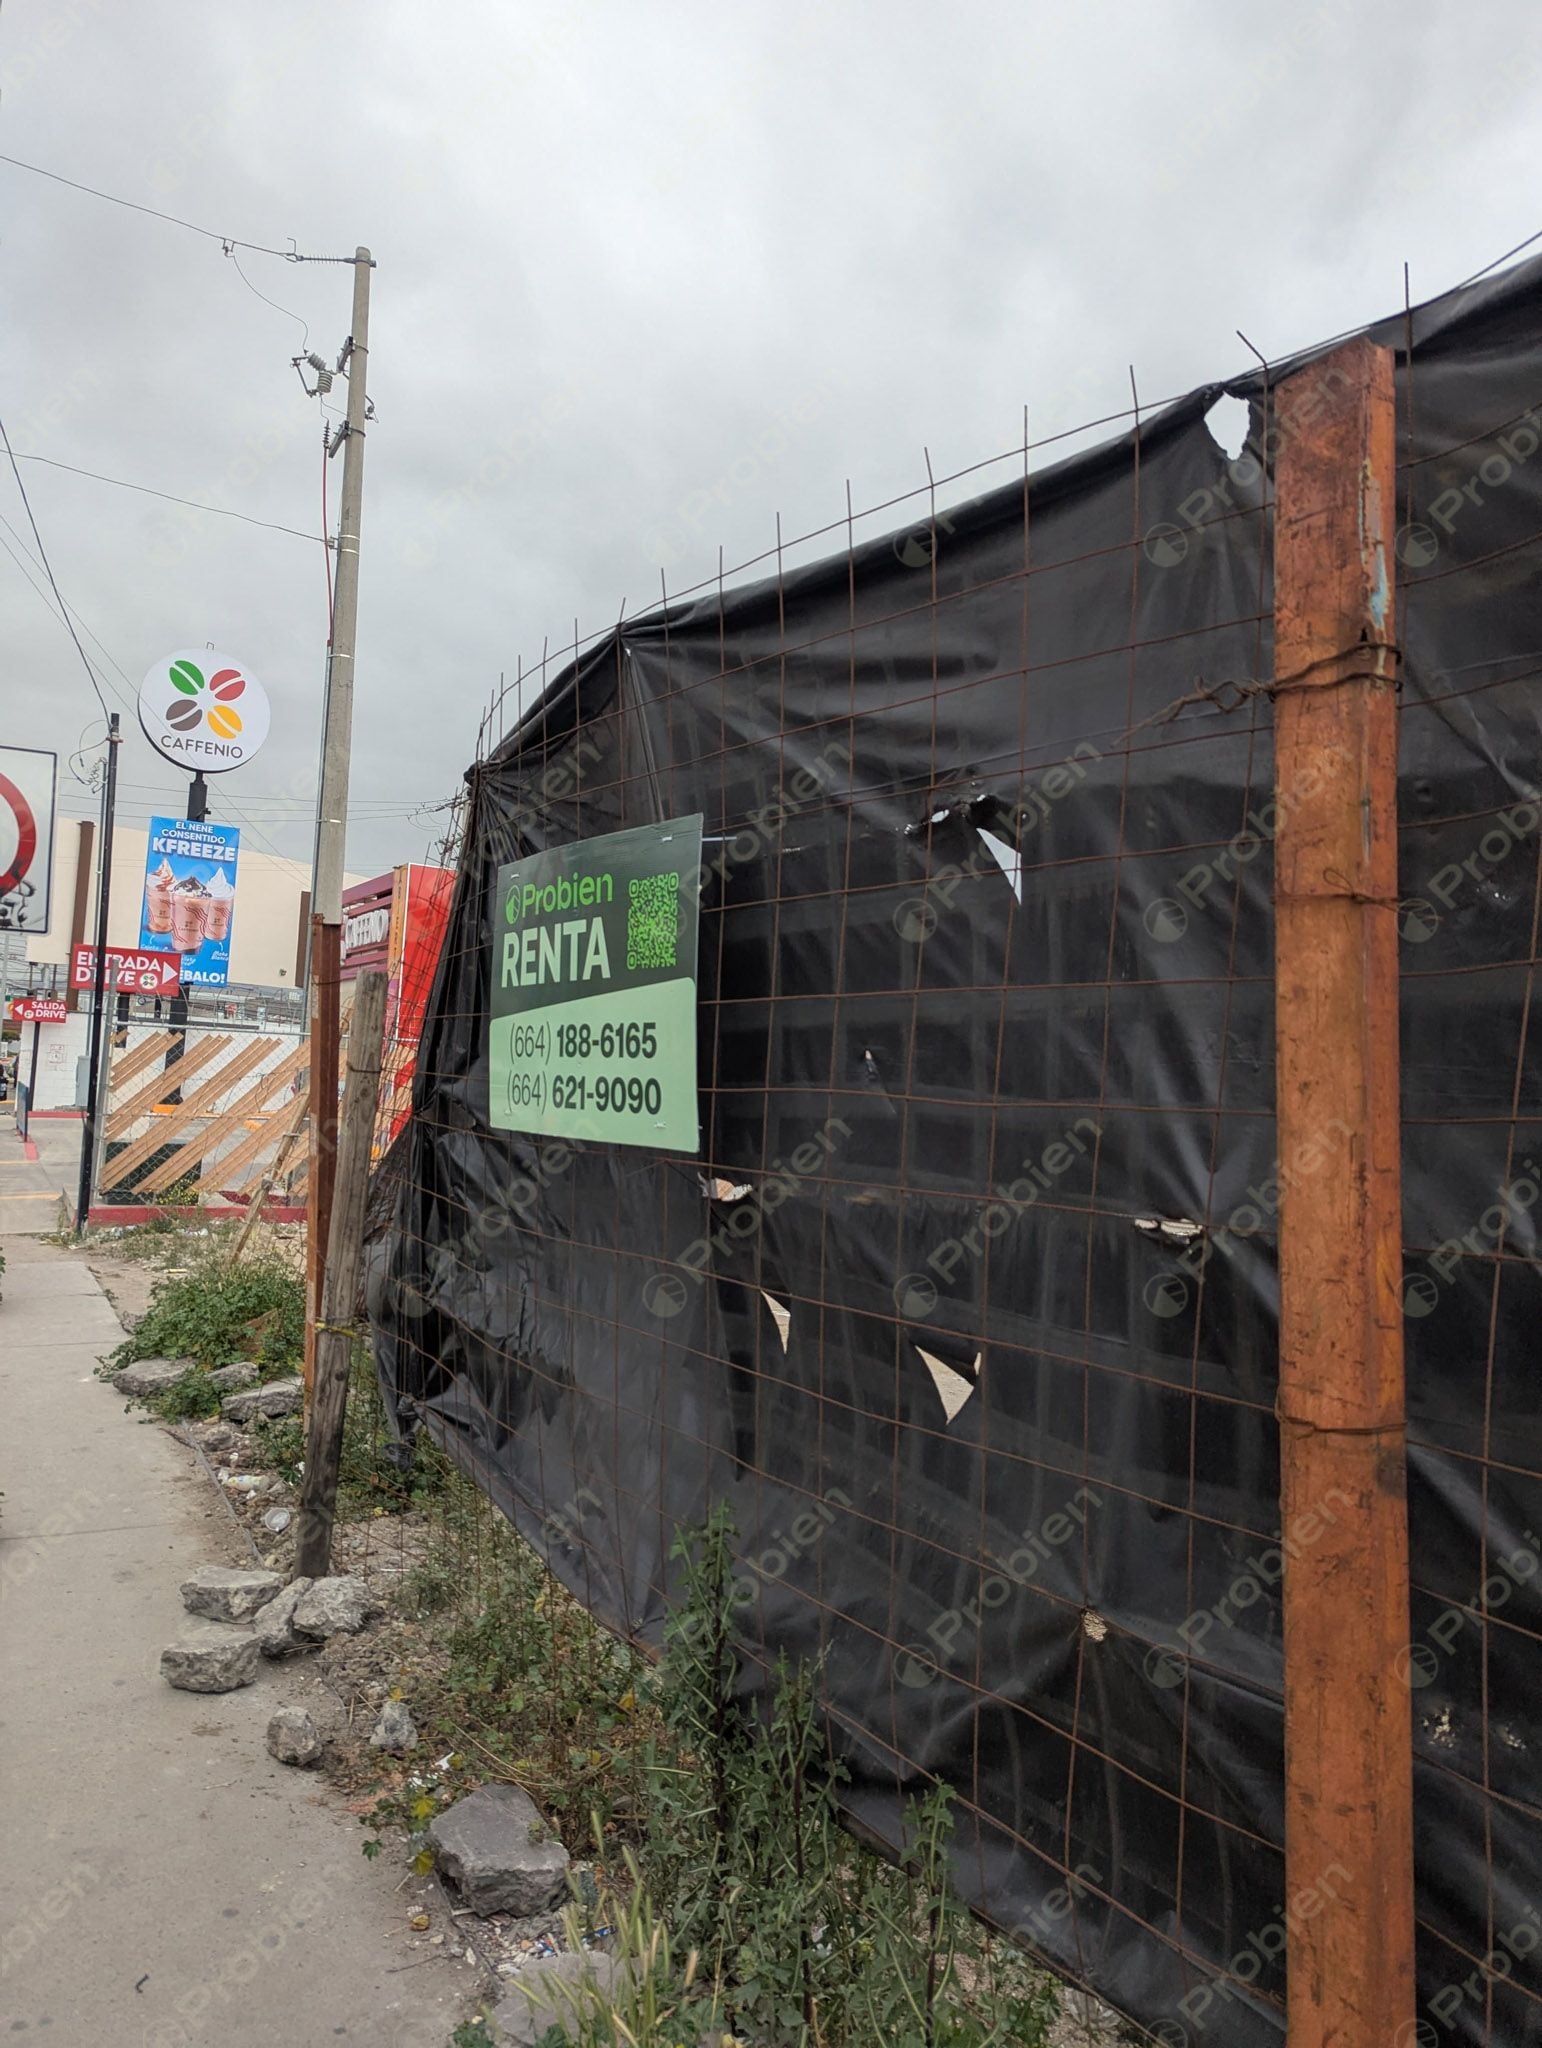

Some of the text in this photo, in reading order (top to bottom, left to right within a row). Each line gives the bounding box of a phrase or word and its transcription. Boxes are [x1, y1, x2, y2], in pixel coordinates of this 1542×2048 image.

[161, 735, 243, 758] CAFFENIO
[161, 829, 226, 844] CONSENTIDO
[175, 821, 214, 834] EL NENE
[153, 838, 235, 861] KFREEZE
[522, 872, 614, 918] Probien
[501, 916, 611, 988] RENTA
[31, 1001, 66, 1011] SALIDA
[35, 1010, 66, 1019] DRIVE
[510, 1020, 657, 1065] (664) 188-6165
[507, 1070, 662, 1115] (664) 621-9090
